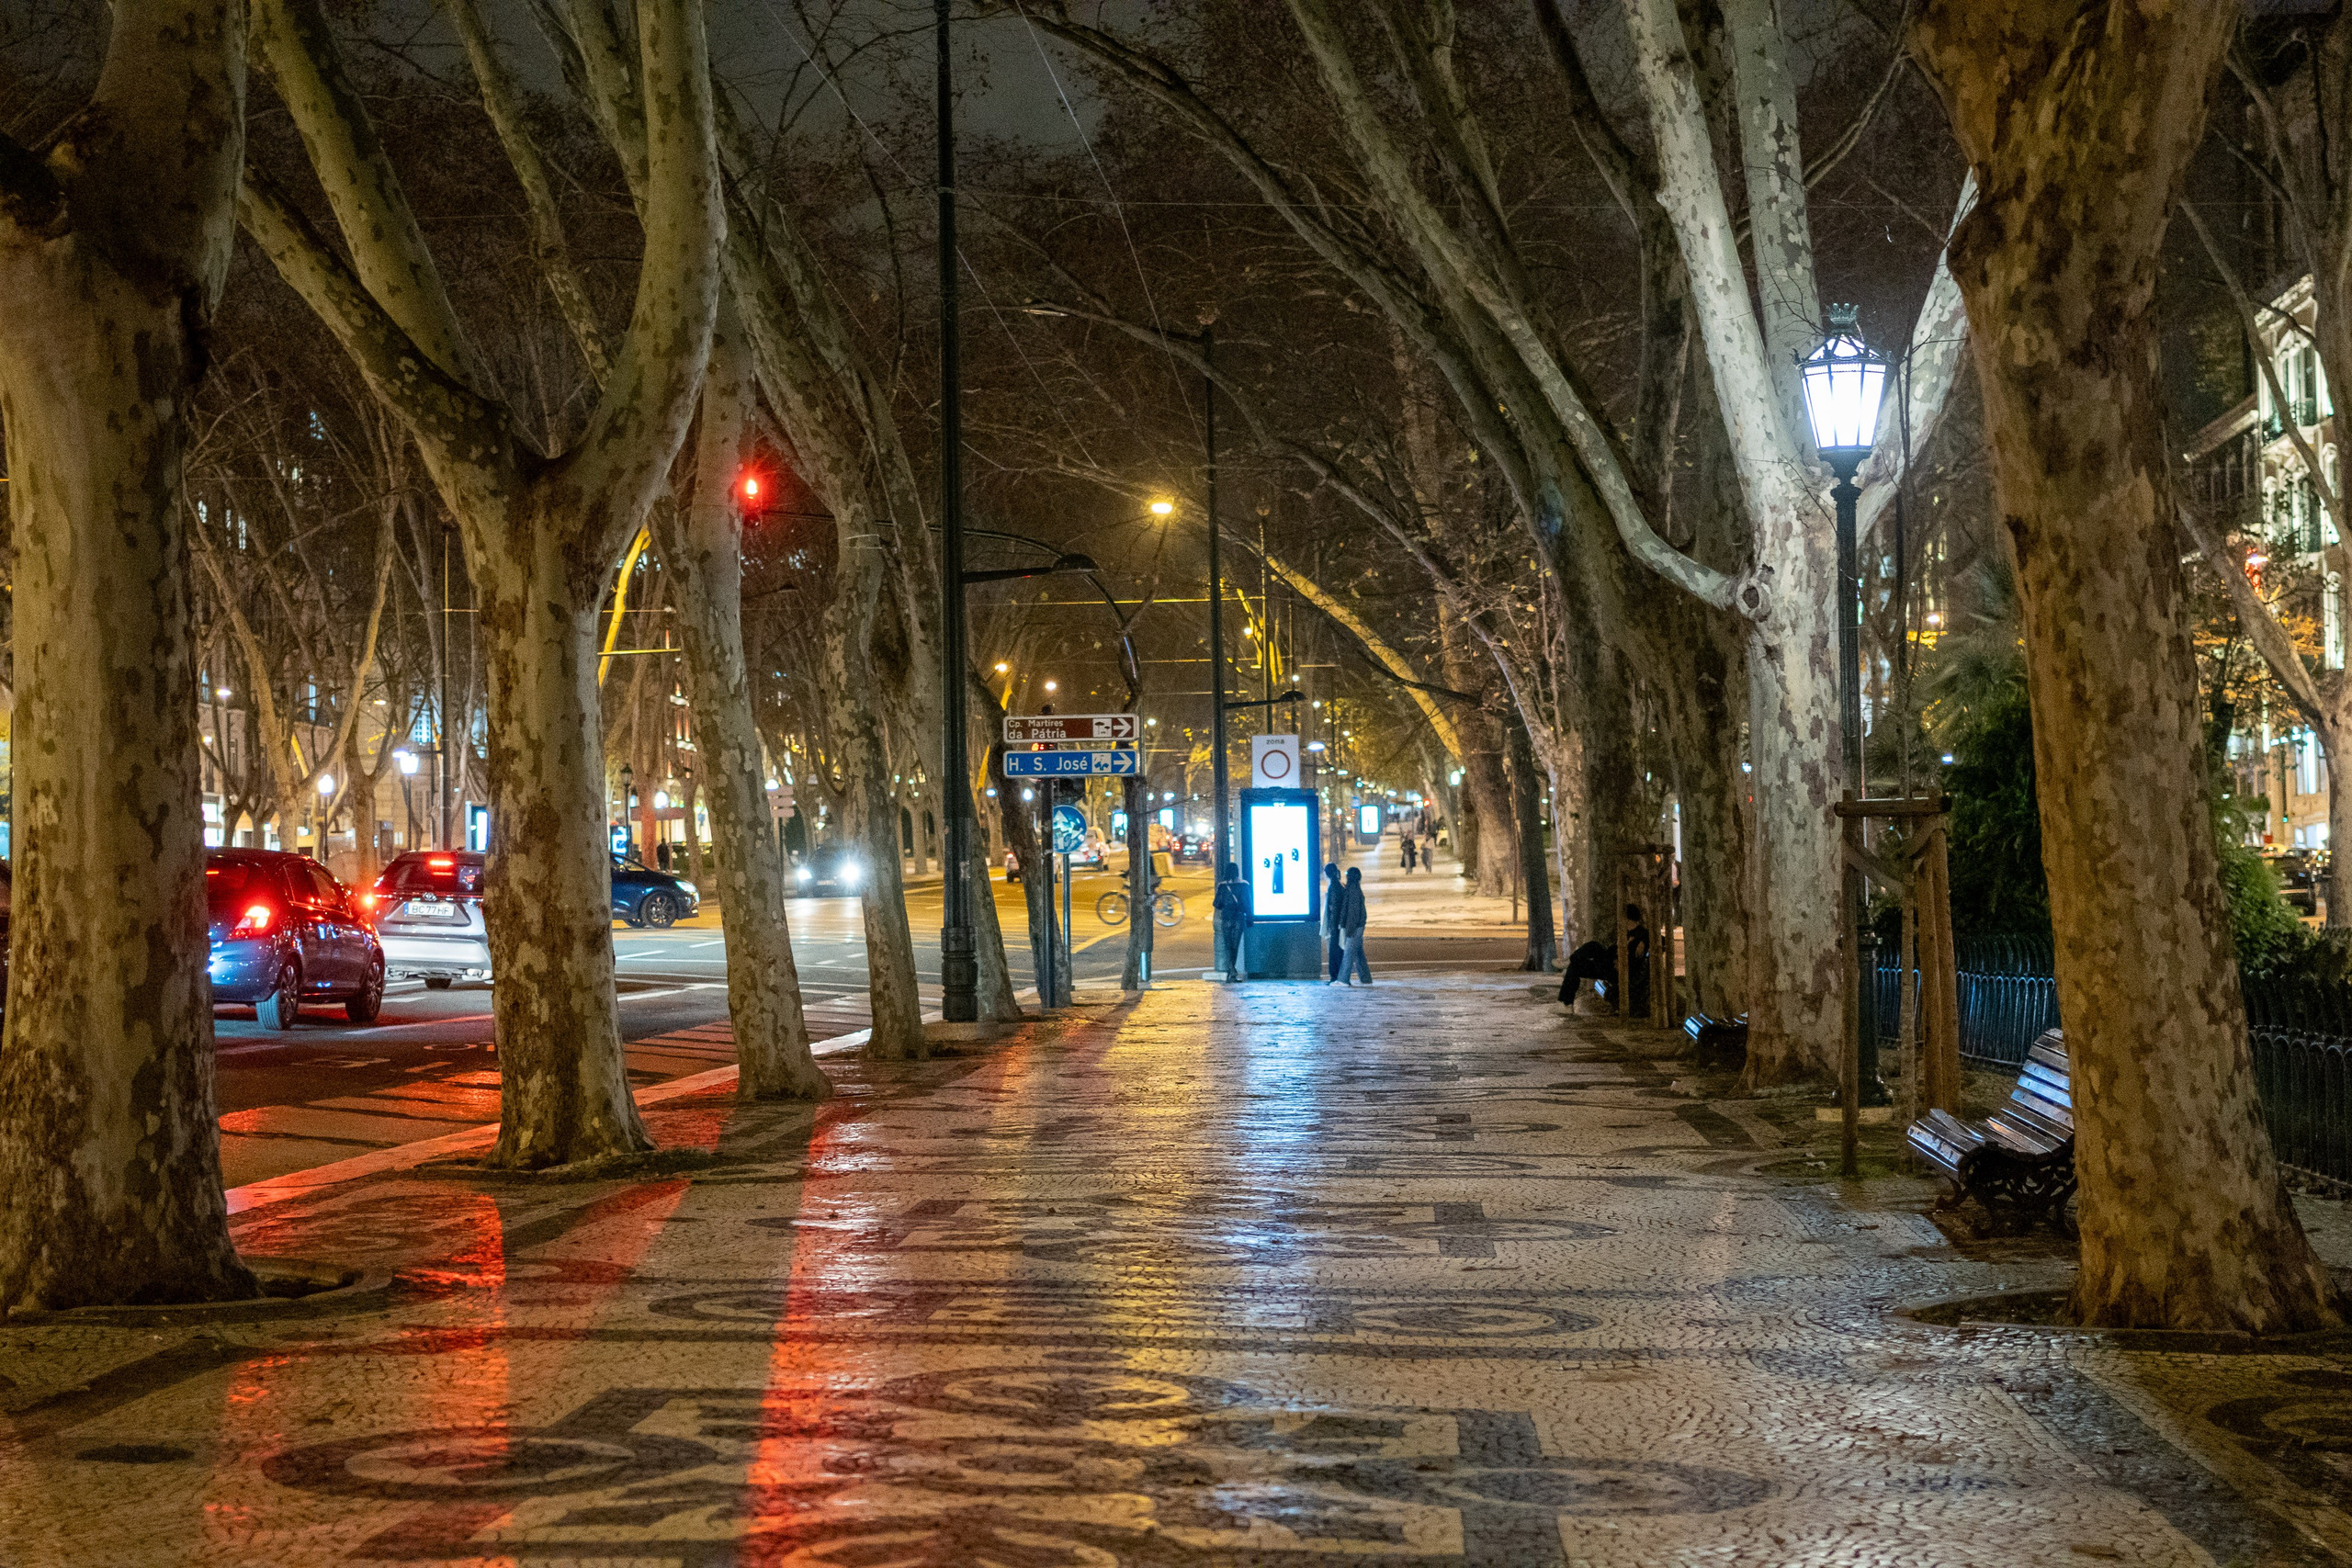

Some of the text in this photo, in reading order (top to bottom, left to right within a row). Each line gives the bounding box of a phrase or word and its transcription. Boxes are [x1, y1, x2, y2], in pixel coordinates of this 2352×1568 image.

[1008, 719, 1023, 728] Cp.
[1009, 728, 1067, 739] da Pátria
[1009, 756, 1088, 772] H. S. José
